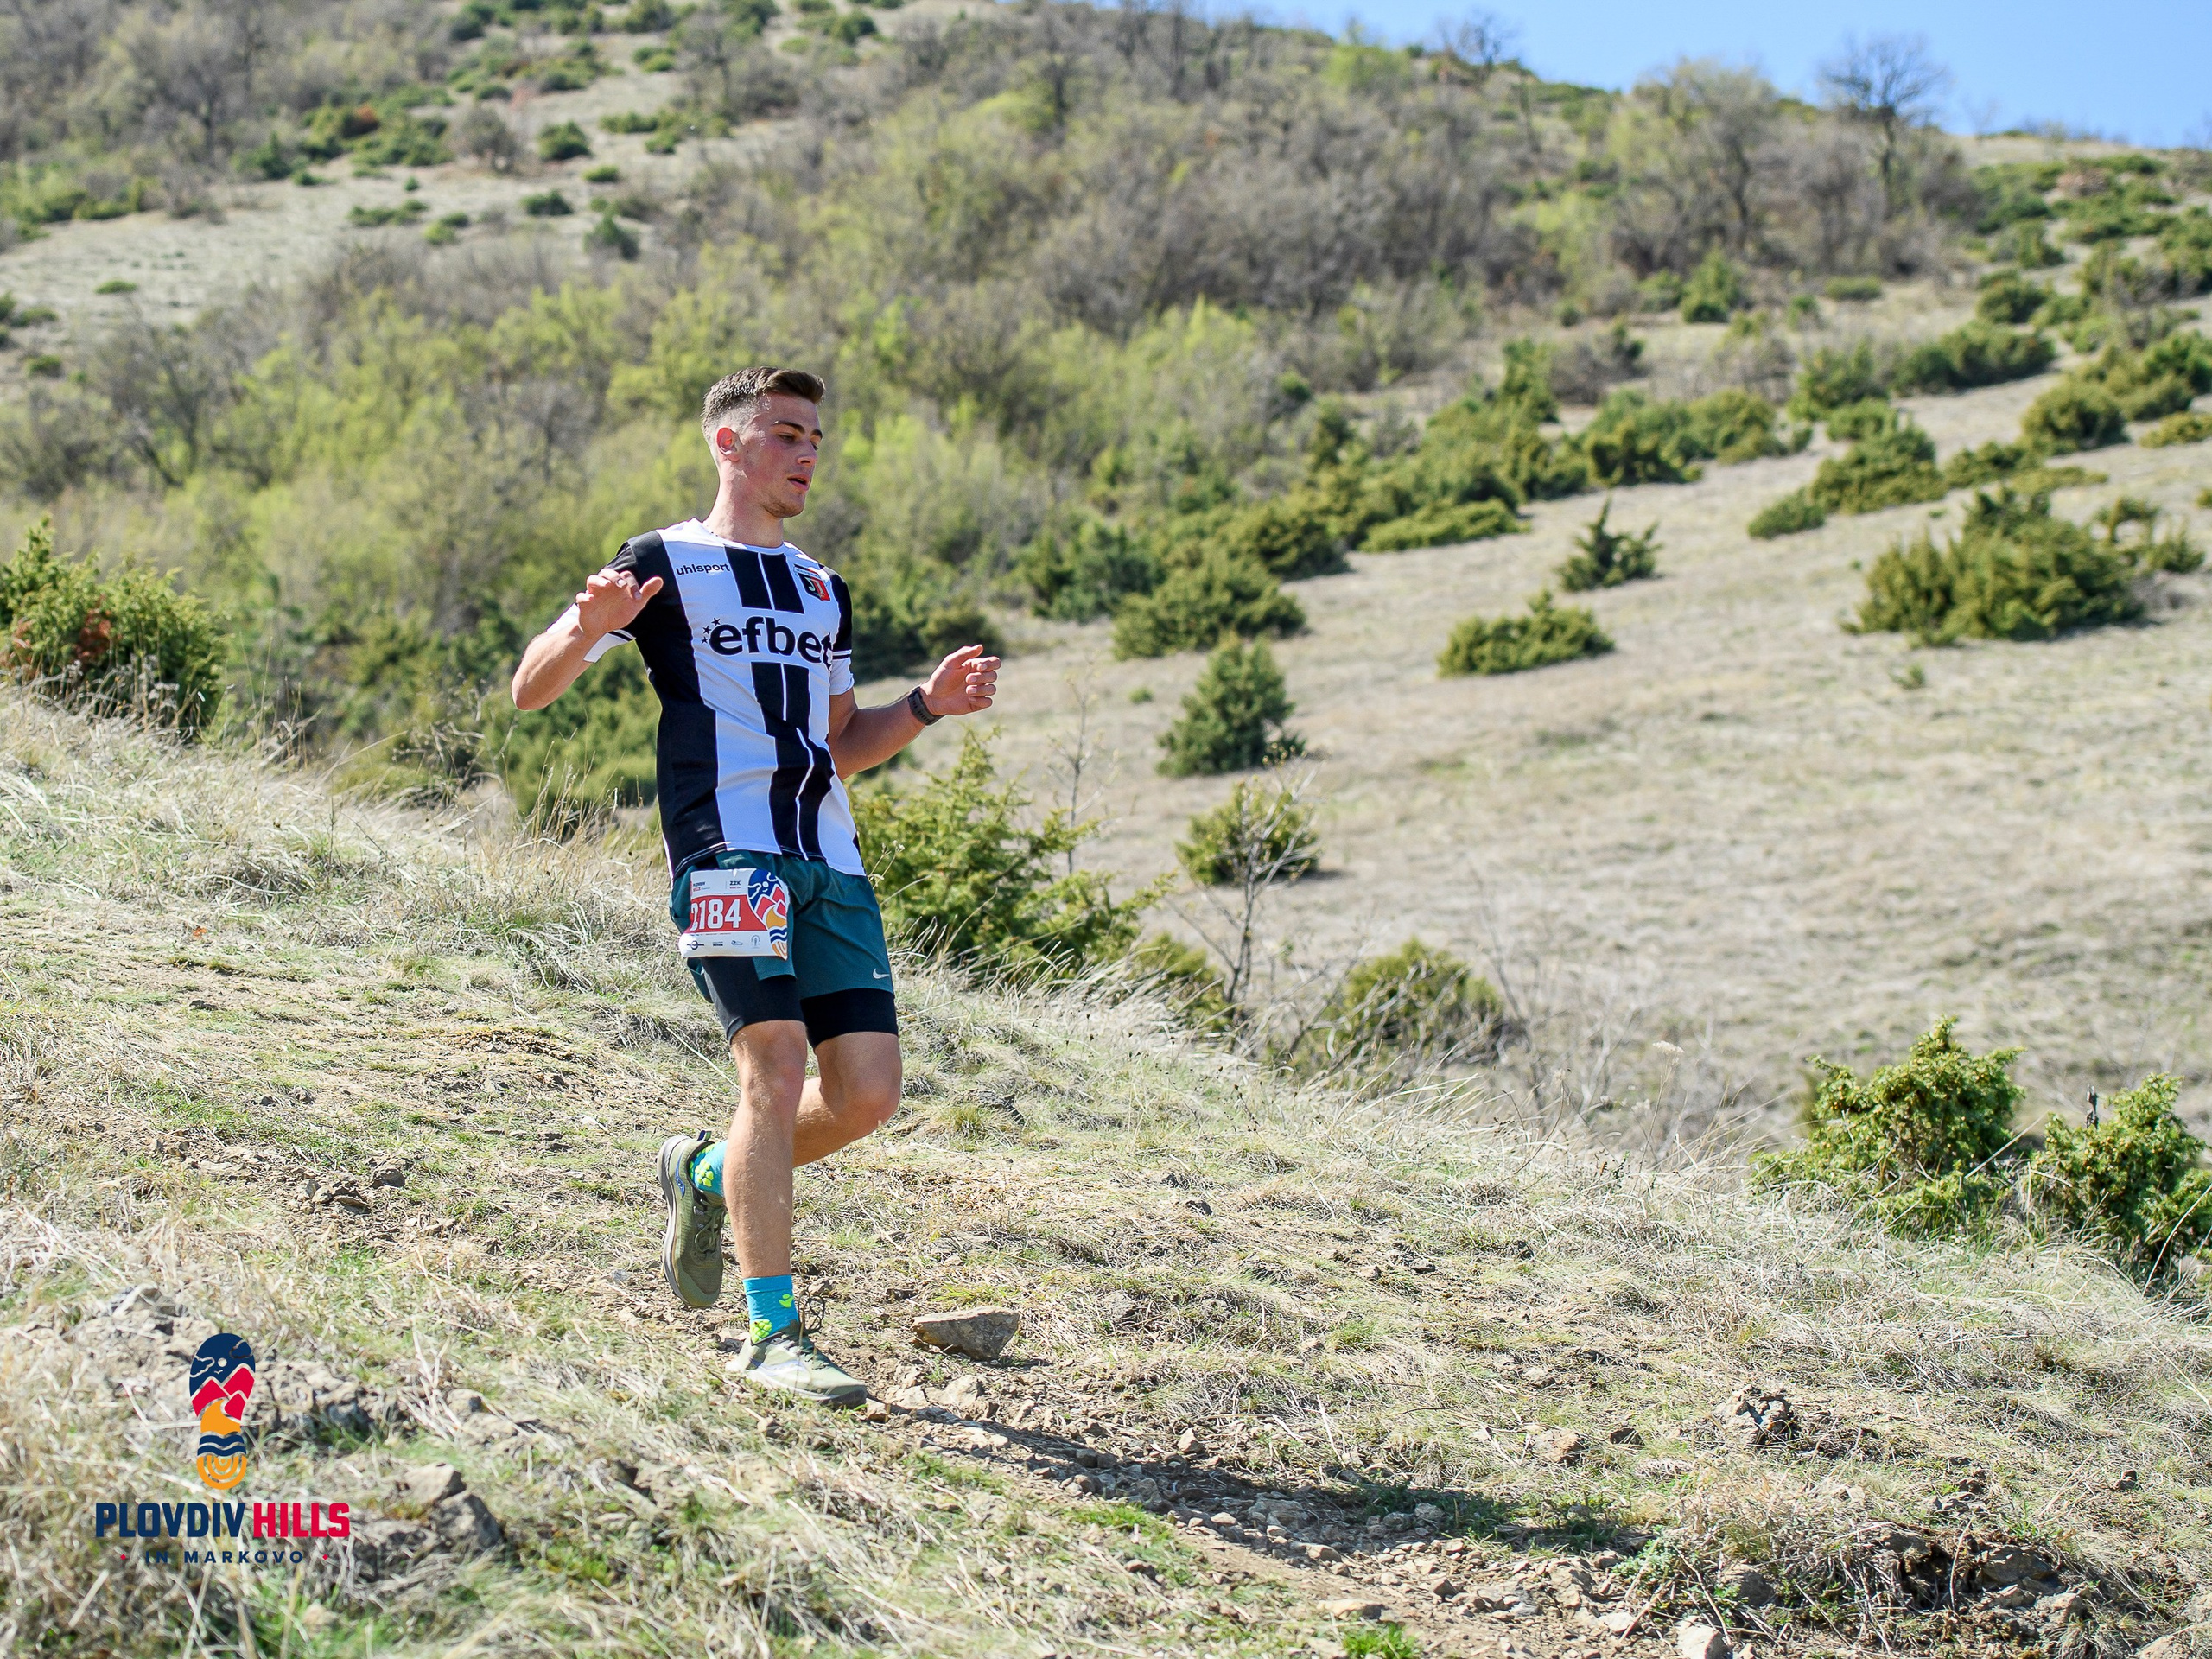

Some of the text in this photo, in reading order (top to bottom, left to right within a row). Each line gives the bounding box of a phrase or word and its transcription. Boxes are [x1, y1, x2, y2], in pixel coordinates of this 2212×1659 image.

[676, 563, 731, 575] uhlsport
[709, 616, 834, 671] efbet
[690, 899, 741, 931] 2184
